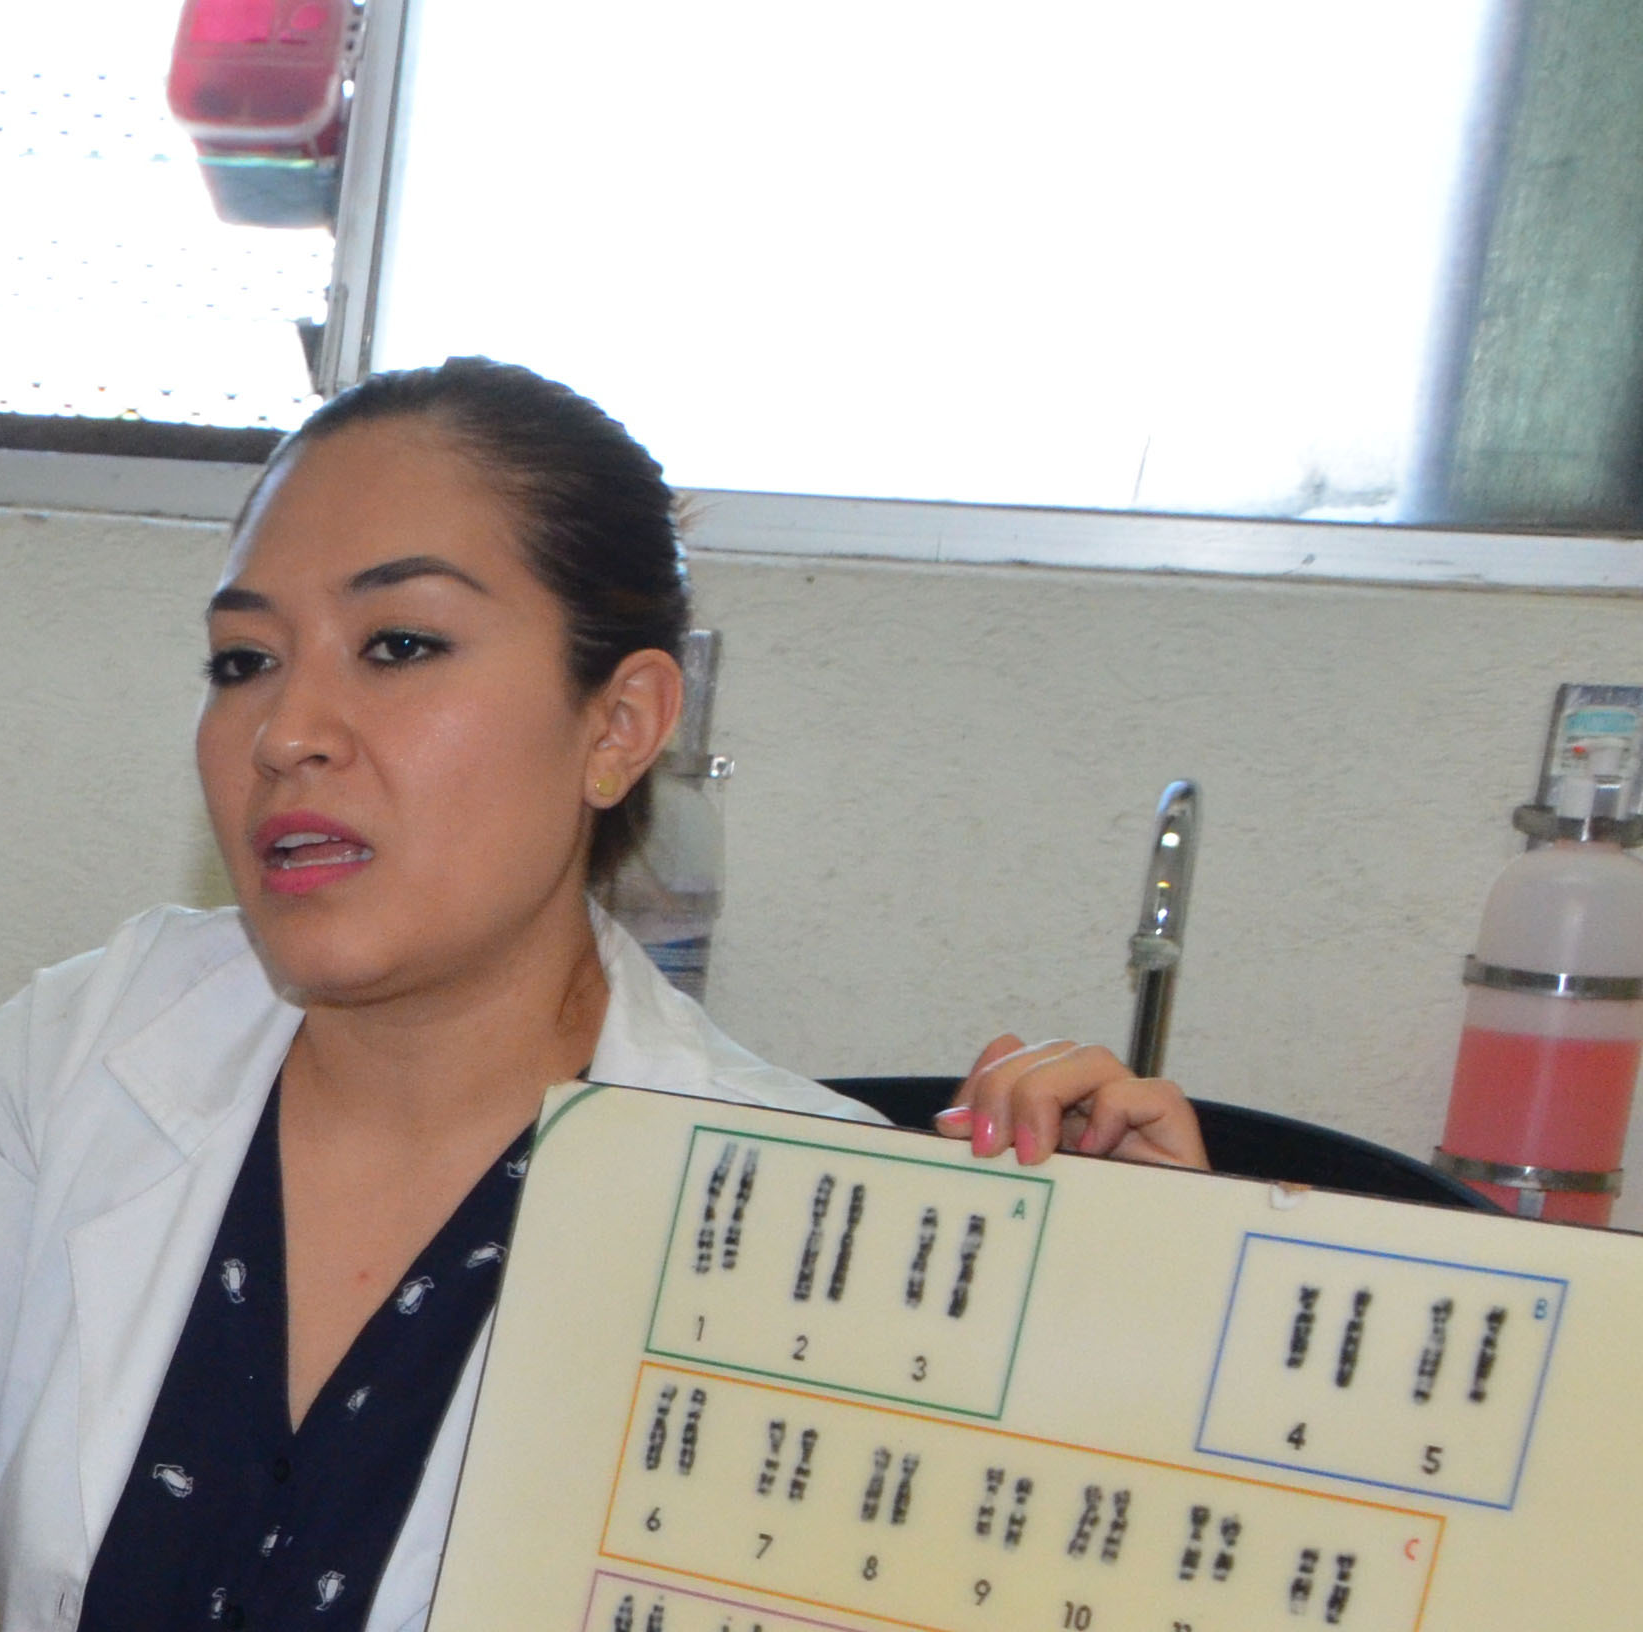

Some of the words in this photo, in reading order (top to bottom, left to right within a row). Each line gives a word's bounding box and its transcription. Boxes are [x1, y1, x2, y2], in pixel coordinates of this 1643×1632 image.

[1011, 1199, 1025, 1220] A
[1533, 1298, 1548, 1321] B
[791, 1334, 809, 1362] 2
[910, 1355, 928, 1383] 3
[1286, 1422, 1306, 1451] 4
[1421, 1445, 1443, 1476] 5
[1403, 1537, 1420, 1561] C
[645, 1507, 662, 1533] 6
[755, 1532, 774, 1560] 7
[861, 1554, 879, 1582] 8
[973, 1578, 992, 1606] 9
[1063, 1600, 1093, 1632] 10
